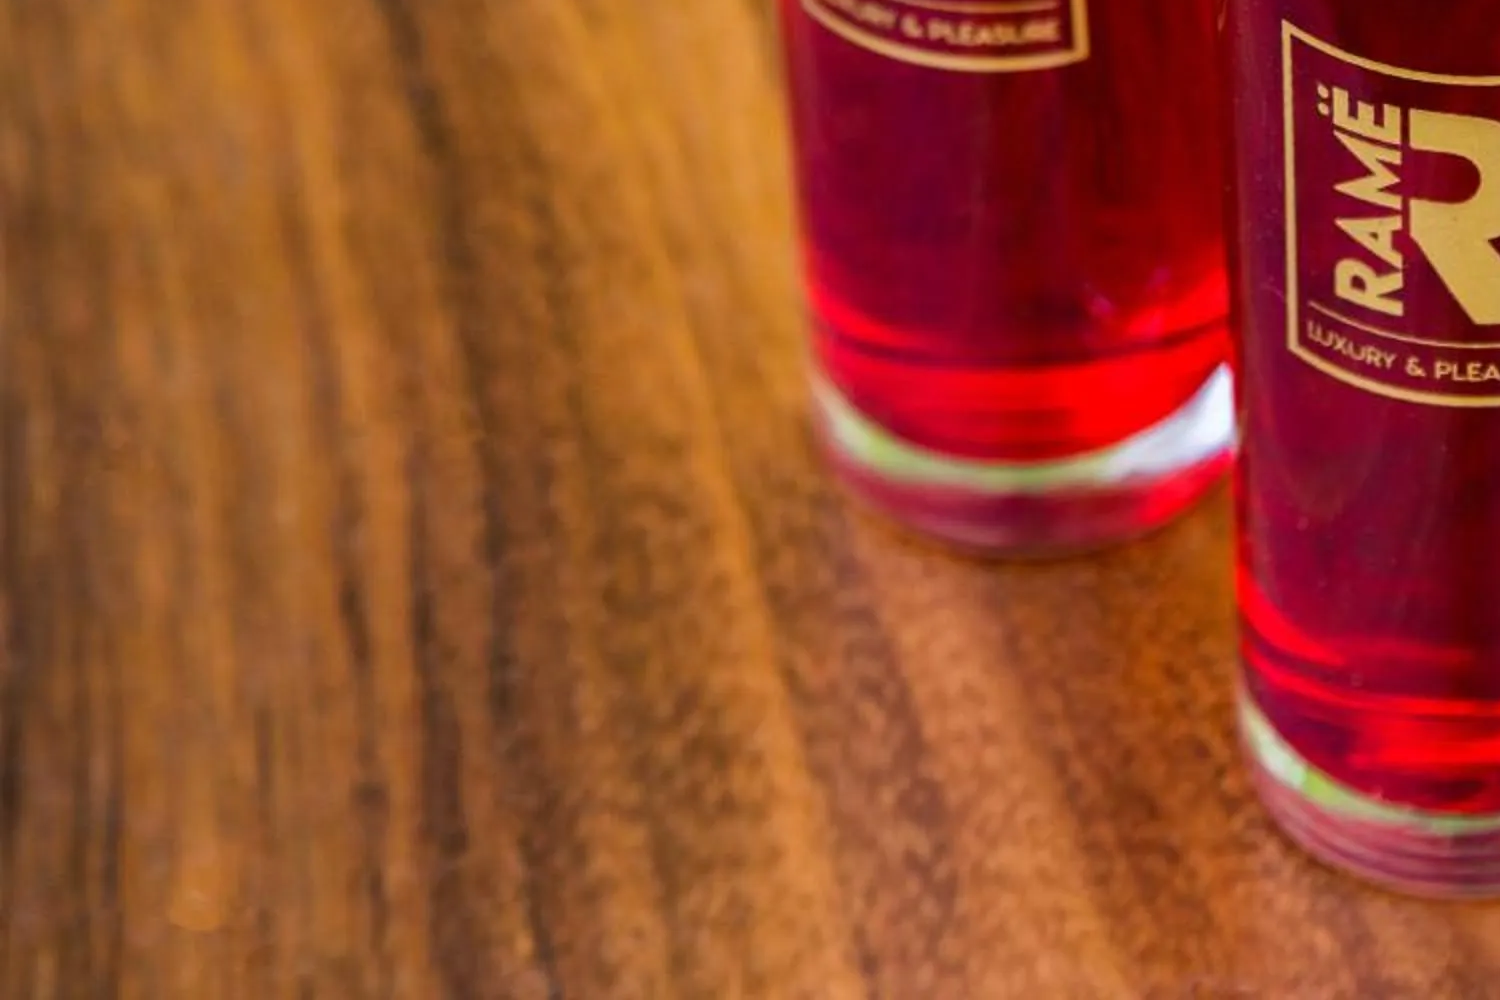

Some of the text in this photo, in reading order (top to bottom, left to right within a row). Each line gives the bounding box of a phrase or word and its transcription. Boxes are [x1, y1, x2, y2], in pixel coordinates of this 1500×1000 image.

[1317, 83, 1404, 316] RAMË
[1307, 320, 1396, 369] LUXURY
[1405, 356, 1426, 377] &
